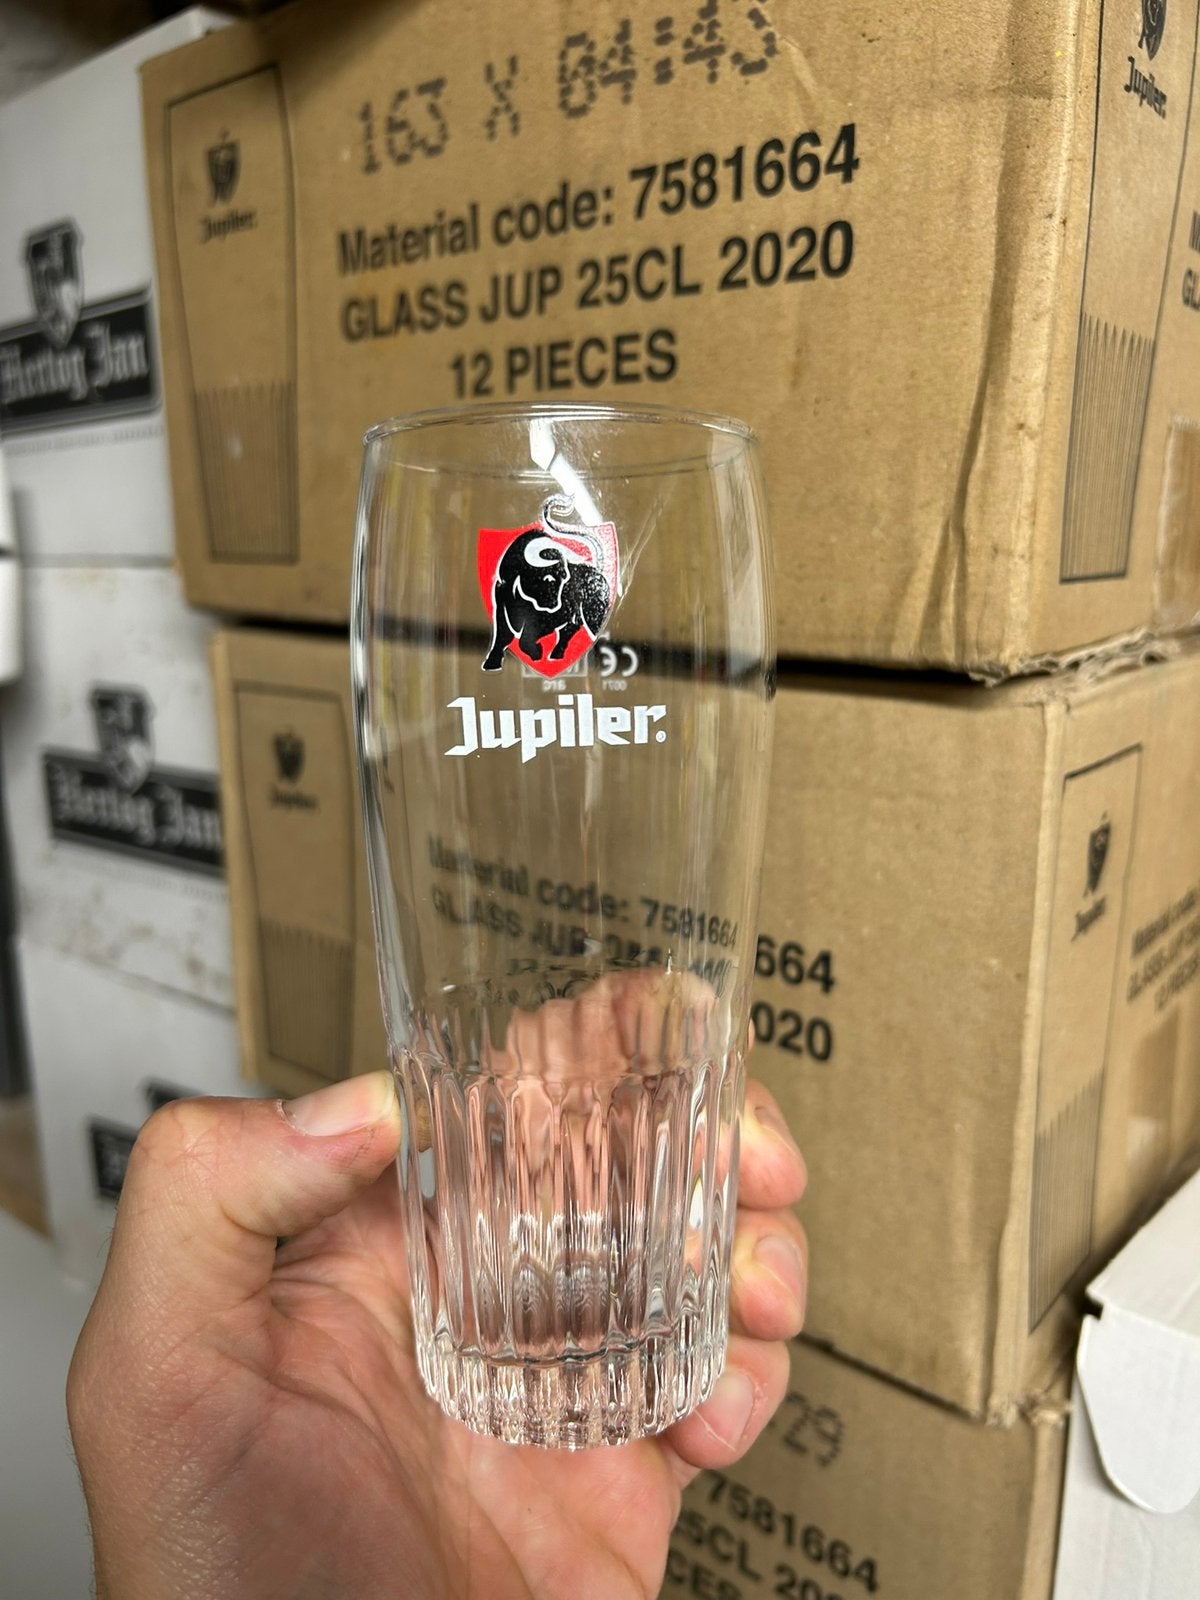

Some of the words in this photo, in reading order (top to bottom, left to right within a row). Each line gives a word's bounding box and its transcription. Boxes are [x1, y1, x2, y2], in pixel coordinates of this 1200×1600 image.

[337, 202, 481, 275] Material
[492, 180, 614, 247] code:
[629, 123, 860, 220] 7581664
[341, 280, 469, 343] GLASS
[479, 264, 564, 325] JUP
[577, 244, 703, 309] 25CL
[717, 220, 855, 292] 2020
[451, 351, 494, 398] 12
[506, 328, 678, 394] PIECES
